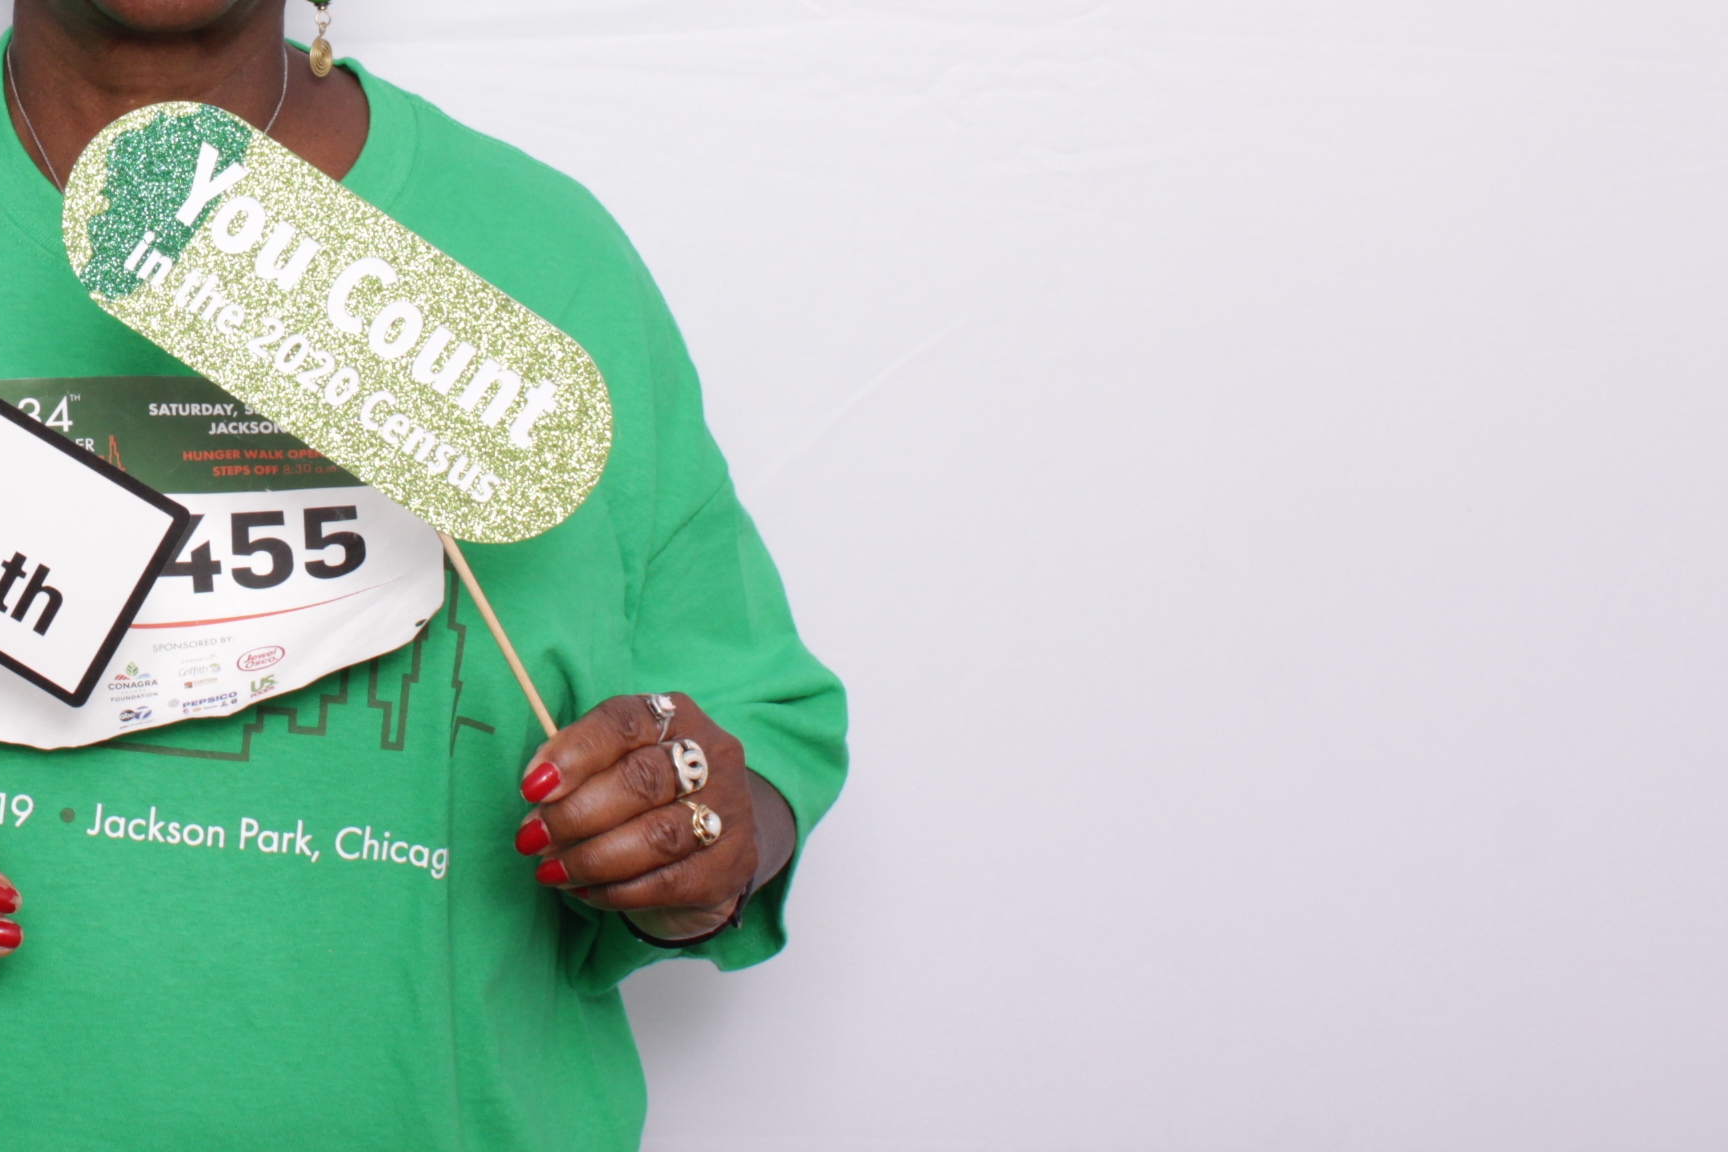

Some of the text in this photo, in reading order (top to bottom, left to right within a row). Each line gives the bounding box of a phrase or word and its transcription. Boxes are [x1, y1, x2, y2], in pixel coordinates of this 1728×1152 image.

[175, 142, 558, 448] You Count
[124, 231, 499, 504] in the 2020 Census
[149, 403, 239, 418] SATURDAY,
[183, 450, 241, 461] HUNGER
[245, 450, 284, 460] WALK
[212, 466, 251, 476] STEPS
[254, 465, 278, 475] OFF
[283, 464, 312, 475] 8:30
[153, 638, 217, 652] SPONSORED
[243, 648, 277, 663] Jewel
[108, 679, 158, 690] CONAGRA
[110, 692, 158, 702] FOUNDATION
[183, 691, 238, 708] PEPSICO
[86, 803, 225, 848] Jackson
[239, 817, 321, 862] Park,
[335, 825, 450, 879] Chicag
